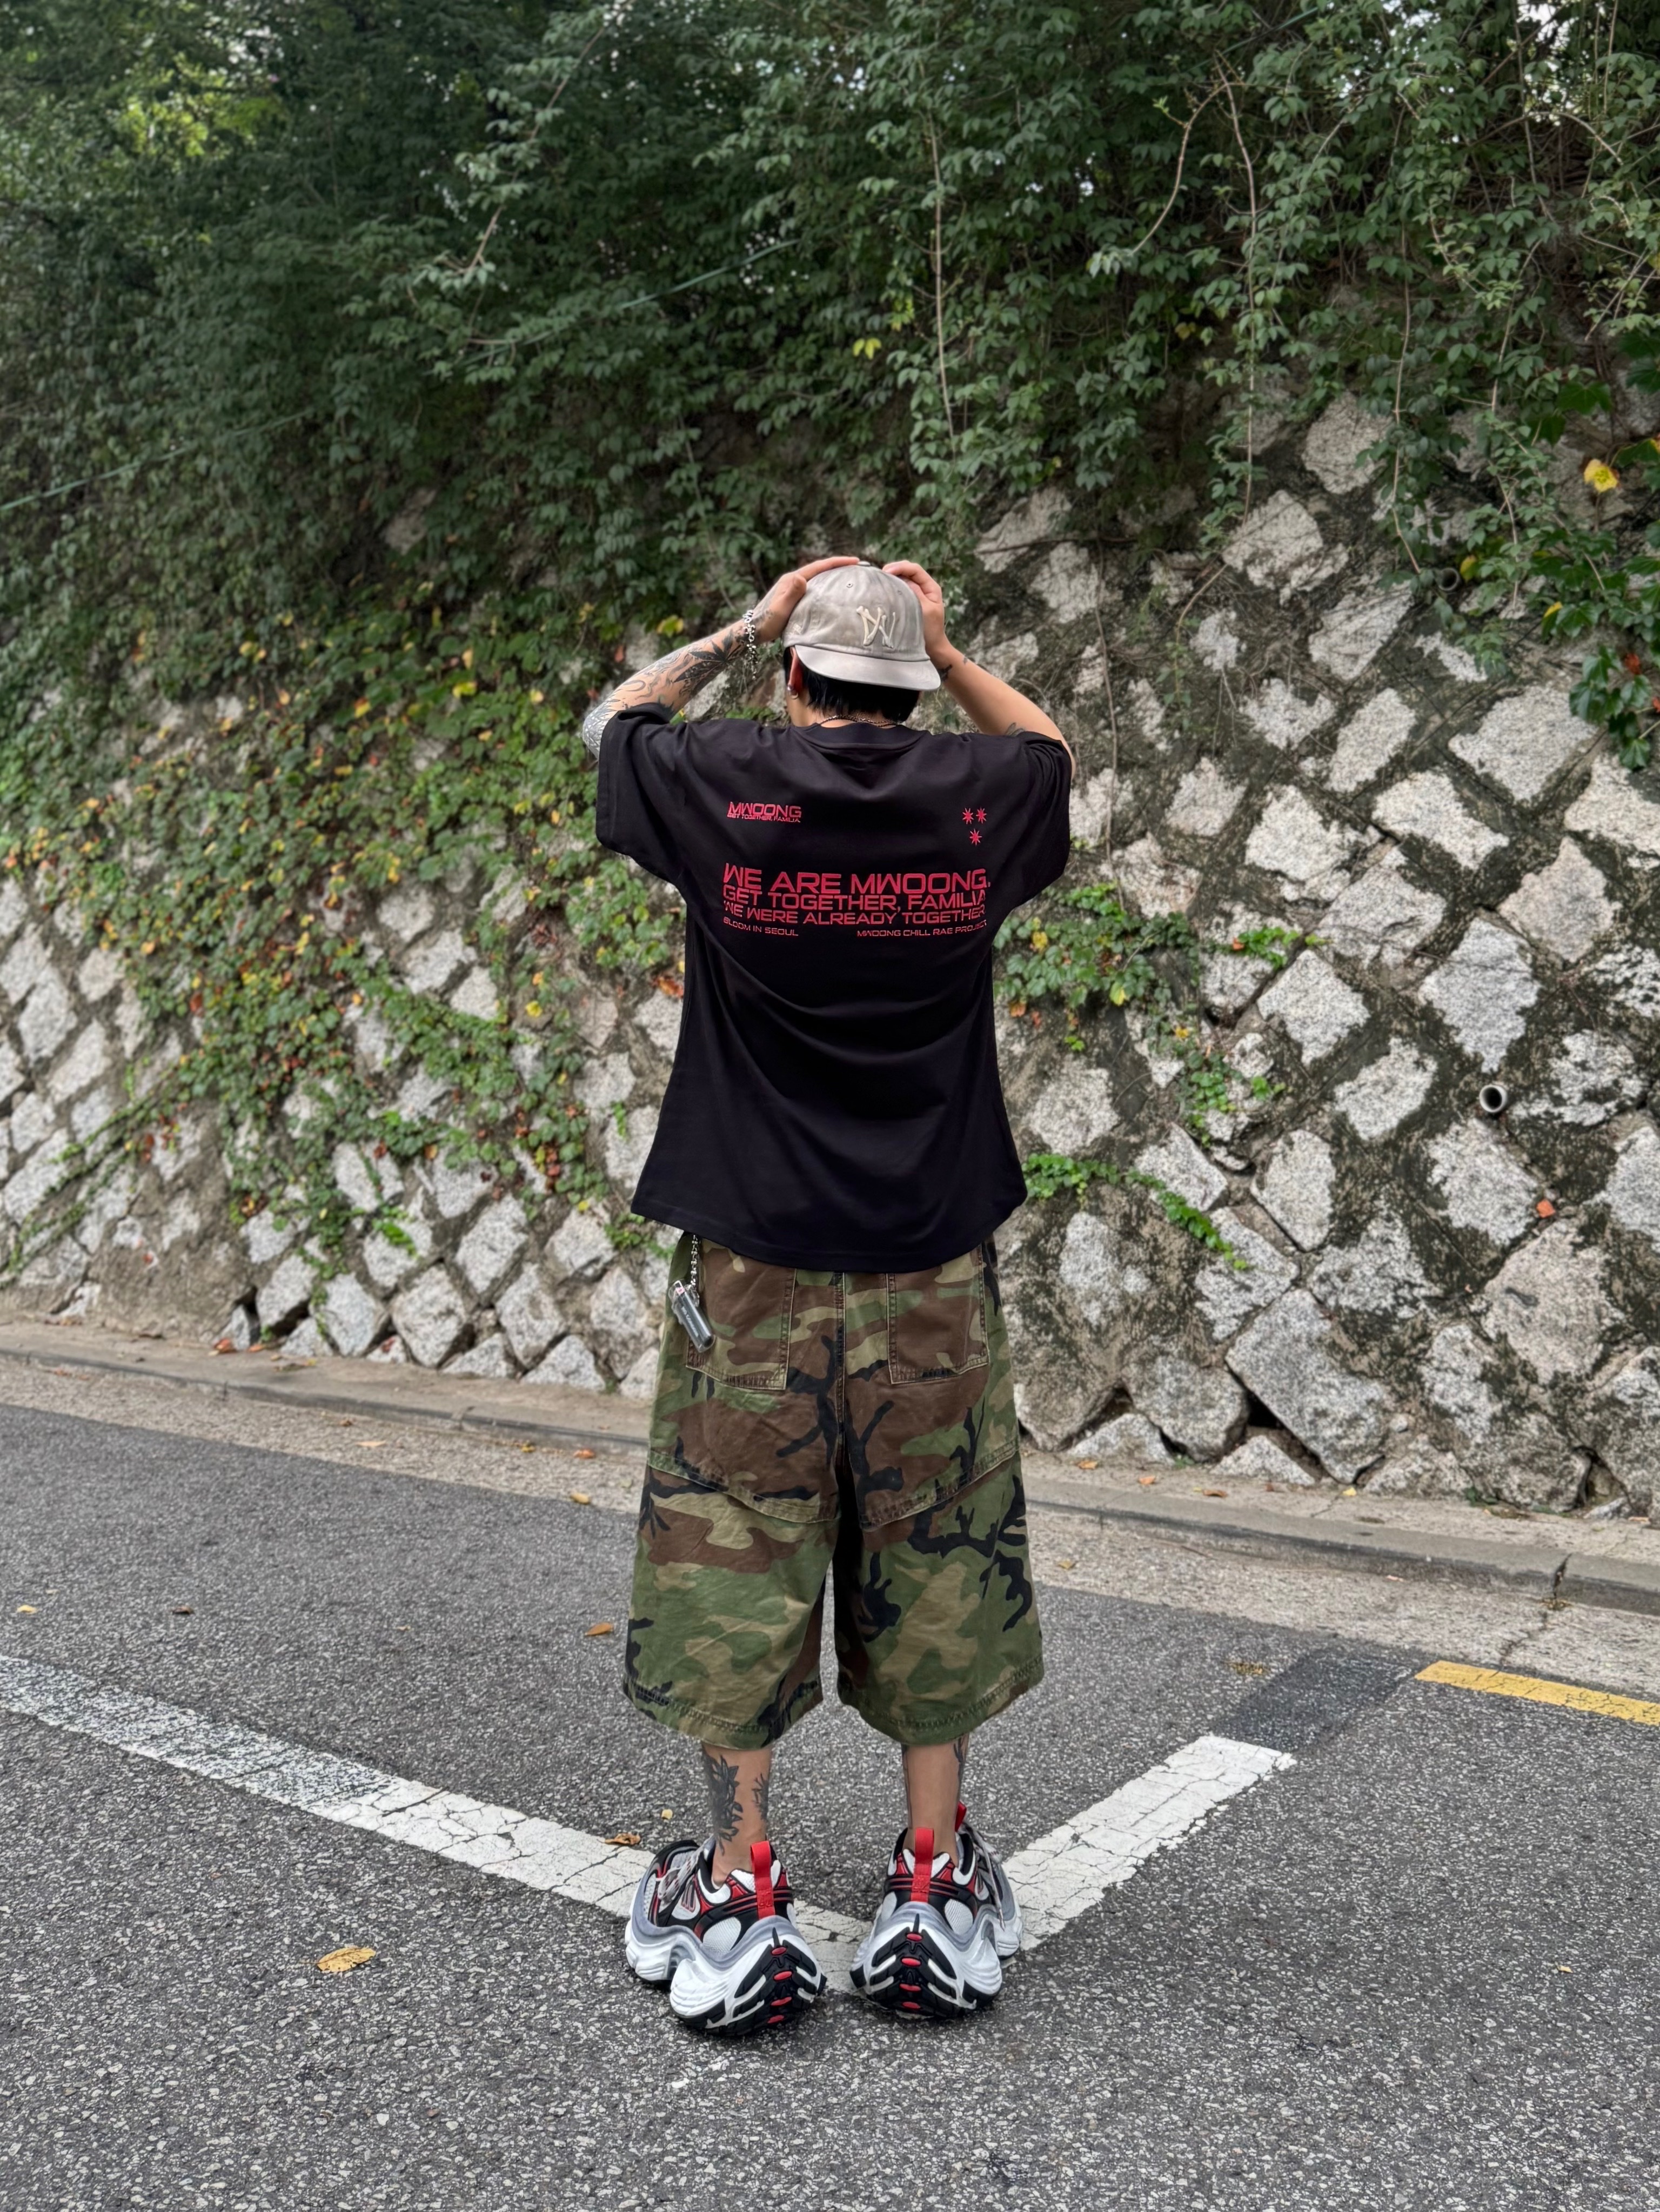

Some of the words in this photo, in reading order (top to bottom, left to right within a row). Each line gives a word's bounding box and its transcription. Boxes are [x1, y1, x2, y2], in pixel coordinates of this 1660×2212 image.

[728, 802, 801, 817] MWOONG
[724, 863, 762, 890] WE
[769, 872, 841, 894] ARE
[723, 884, 762, 906] GET
[768, 892, 901, 912] TOGETHER,
[908, 889, 986, 910] FAMILIA
[724, 900, 744, 917] WE
[747, 907, 798, 923] WERE
[803, 912, 897, 924] ALREADY
[902, 904, 985, 924] TOGETHER
[723, 916, 751, 931] BLOOM
[765, 927, 798, 936] SEOUL
[955, 920, 987, 933] PROJECT
